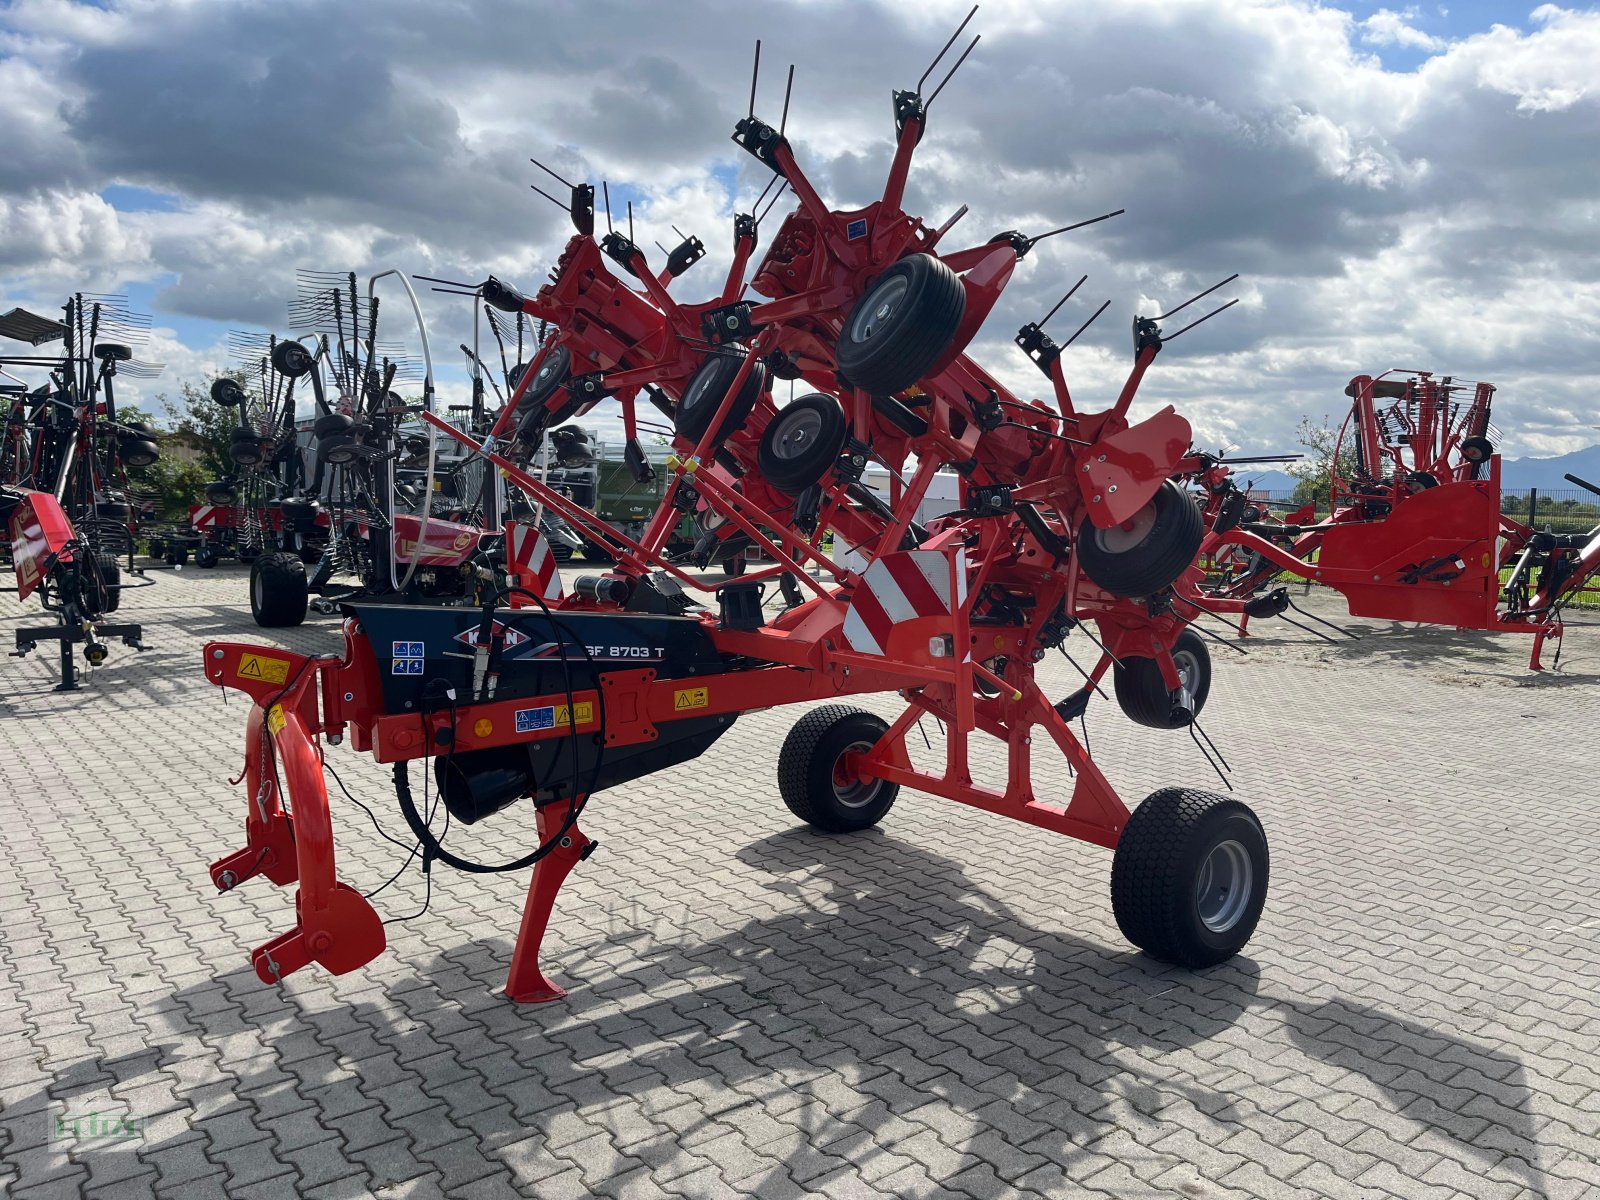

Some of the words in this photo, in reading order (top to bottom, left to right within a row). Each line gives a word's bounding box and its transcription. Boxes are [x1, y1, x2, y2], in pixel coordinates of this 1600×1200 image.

[468, 632, 518, 645] KN
[609, 646, 650, 657] 8703
[654, 647, 665, 658] T
